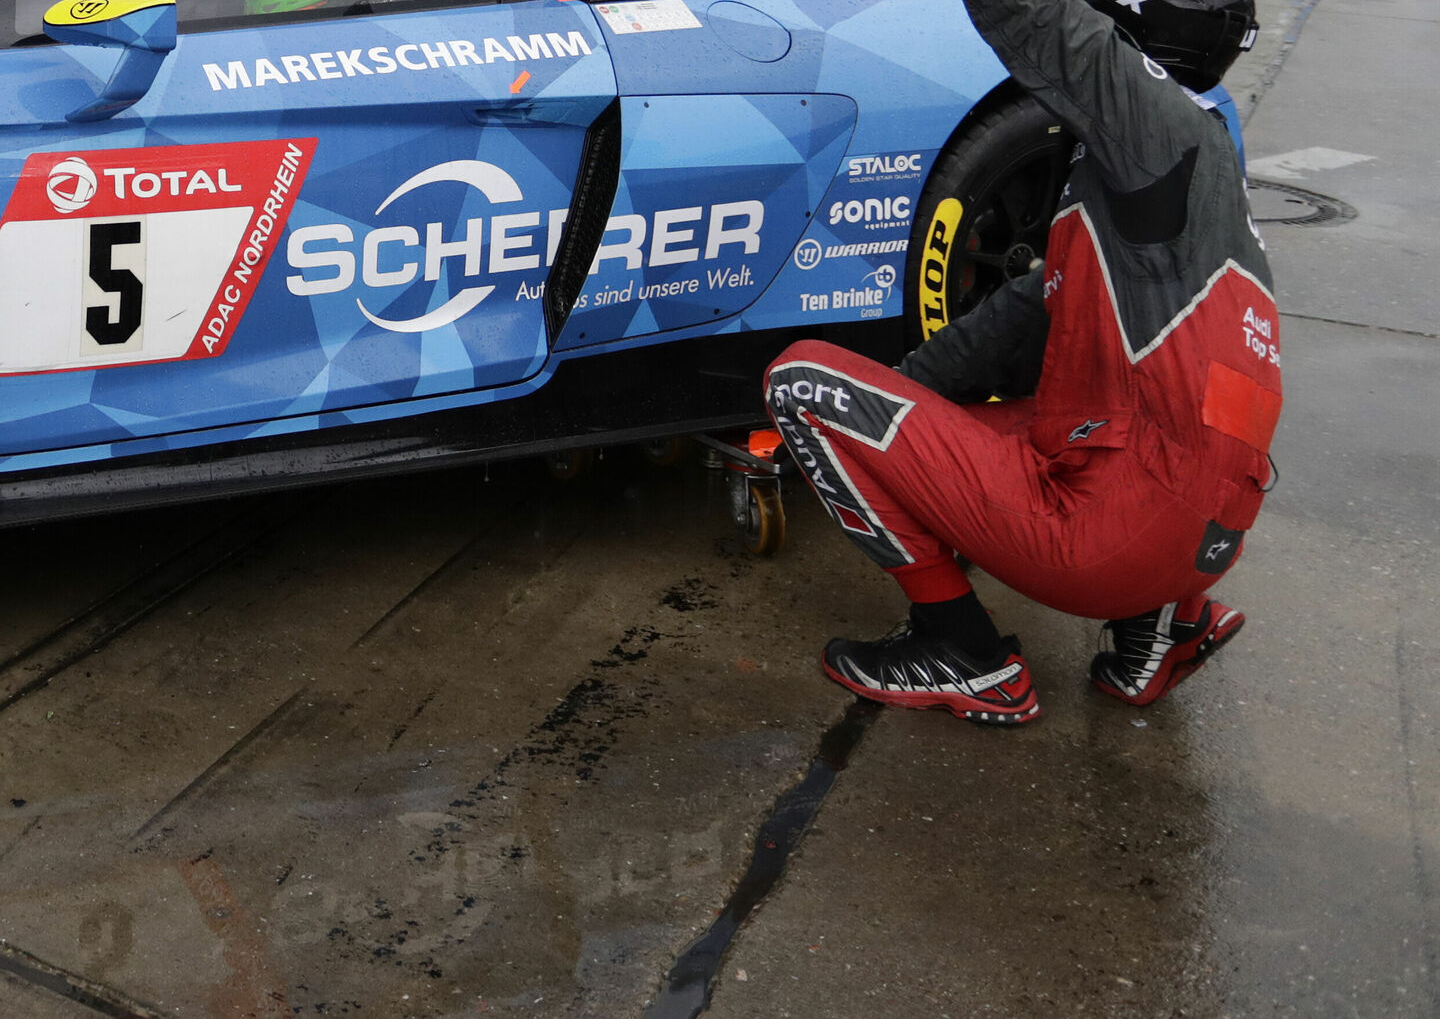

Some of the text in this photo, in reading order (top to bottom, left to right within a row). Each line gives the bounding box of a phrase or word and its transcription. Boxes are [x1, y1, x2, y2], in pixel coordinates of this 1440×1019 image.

[201, 30, 592, 91] MAREKSCHRAMM
[848, 153, 922, 176] STALOC
[104, 166, 242, 200] TOTAL
[864, 220, 910, 231] equipment
[200, 141, 304, 355] ADAC NORDRHEIN
[824, 239, 909, 259] WARRIOR
[85, 221, 144, 346] 5
[593, 280, 633, 307] sind
[637, 279, 700, 301] unsere
[706, 264, 755, 290] Welt.
[800, 288, 884, 312] Ten Brinke
[861, 308, 883, 319] Group
[1242, 306, 1272, 340] Audi
[1242, 326, 1267, 360] Top
